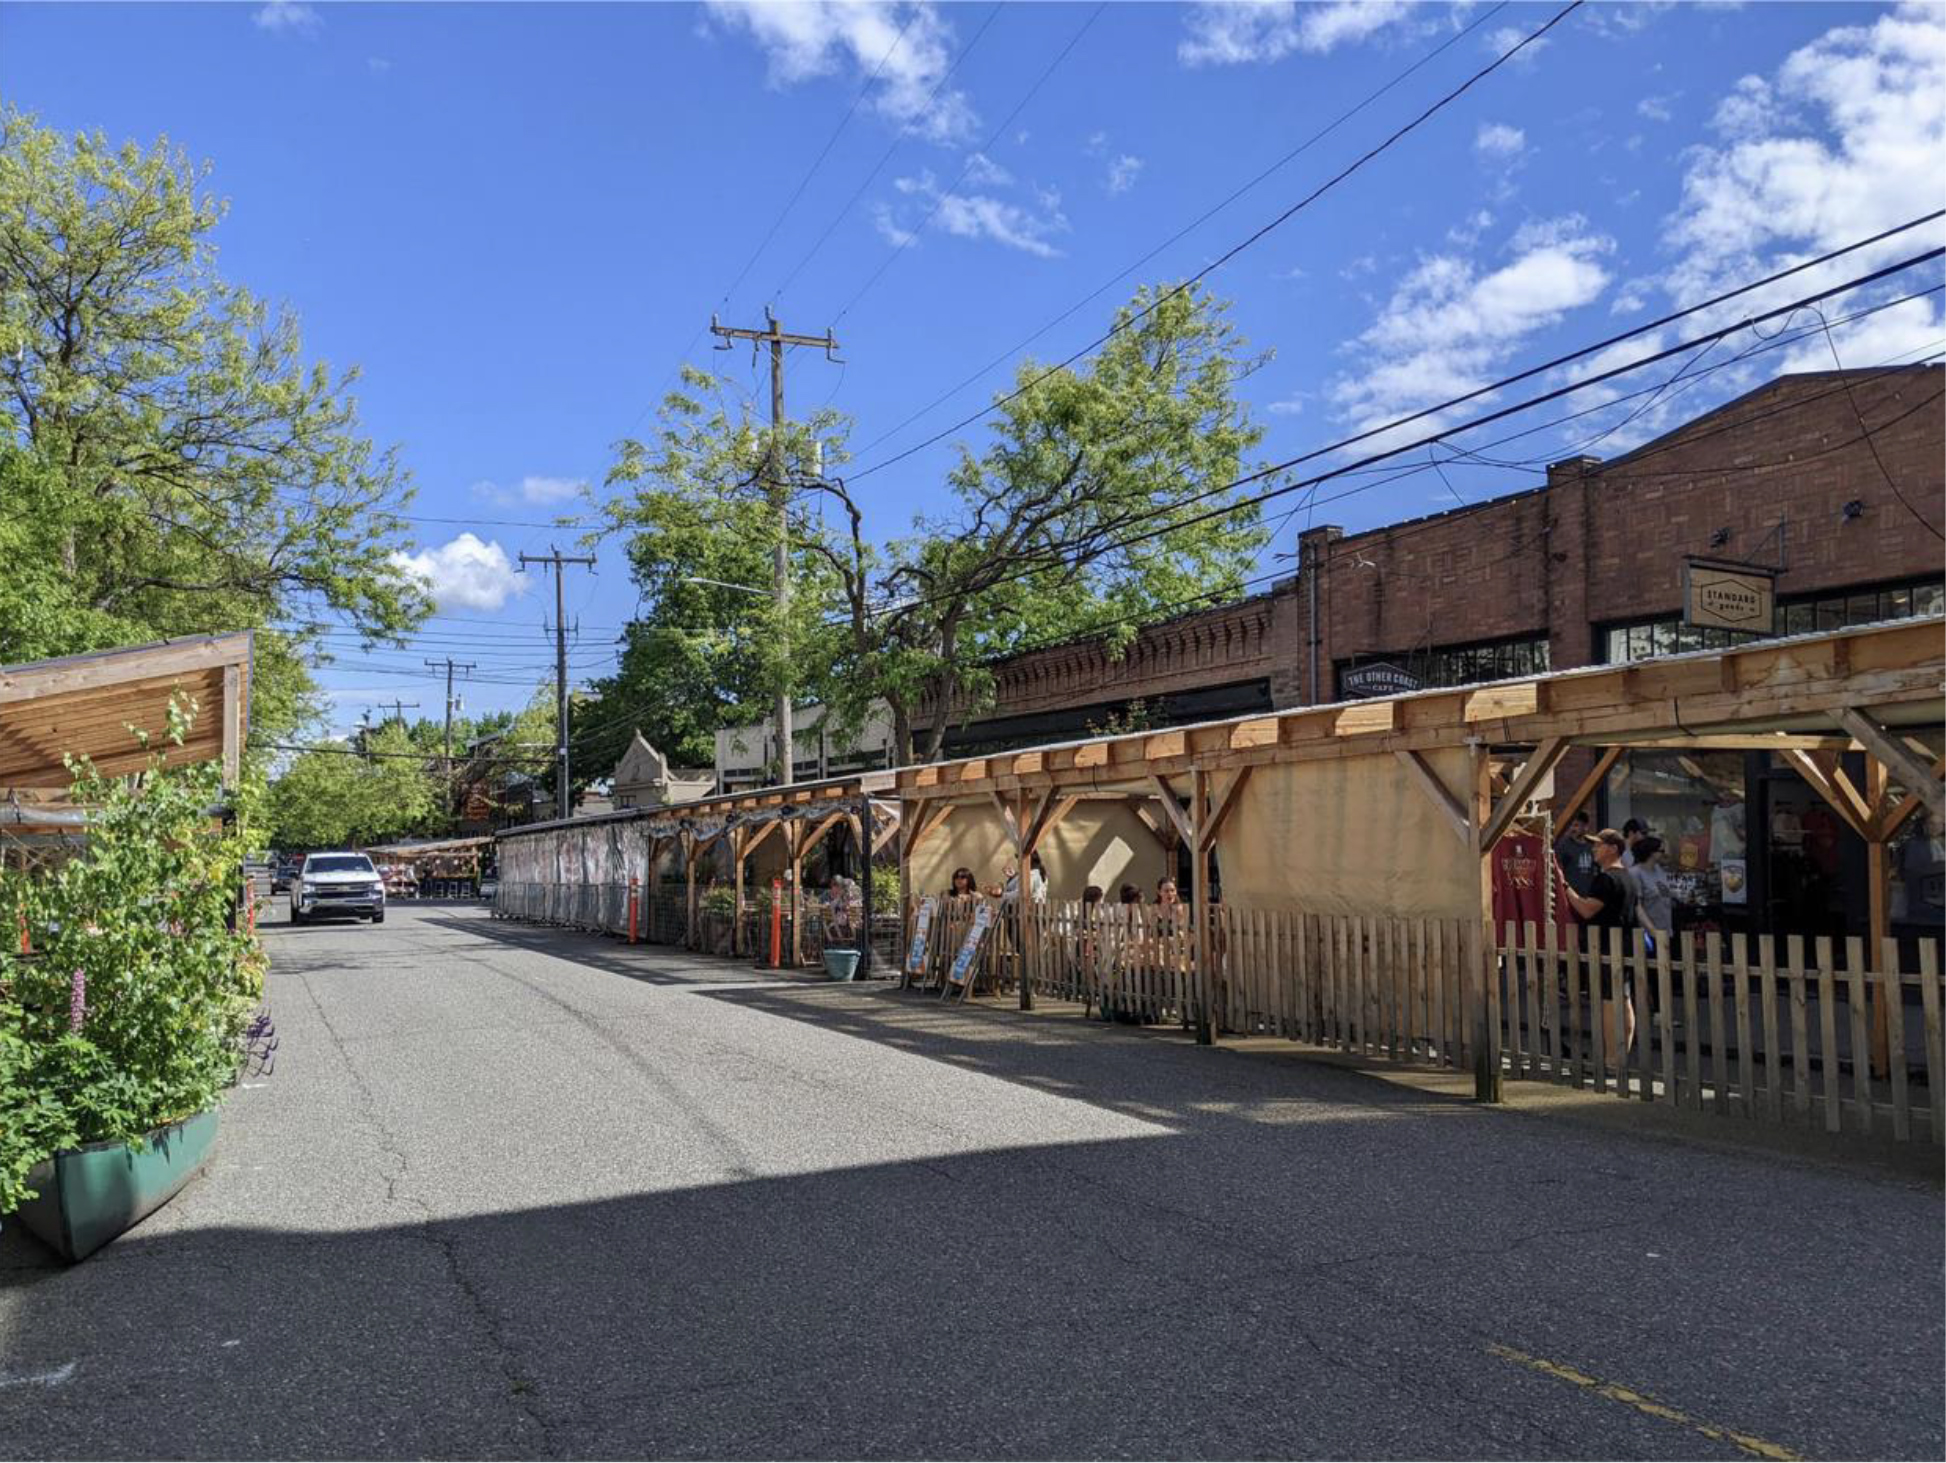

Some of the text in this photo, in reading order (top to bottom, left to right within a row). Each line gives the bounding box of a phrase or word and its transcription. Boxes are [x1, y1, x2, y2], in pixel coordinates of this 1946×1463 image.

[1708, 590, 1755, 604] STANDARD
[1348, 671, 1418, 690] THE OTHER COAST
